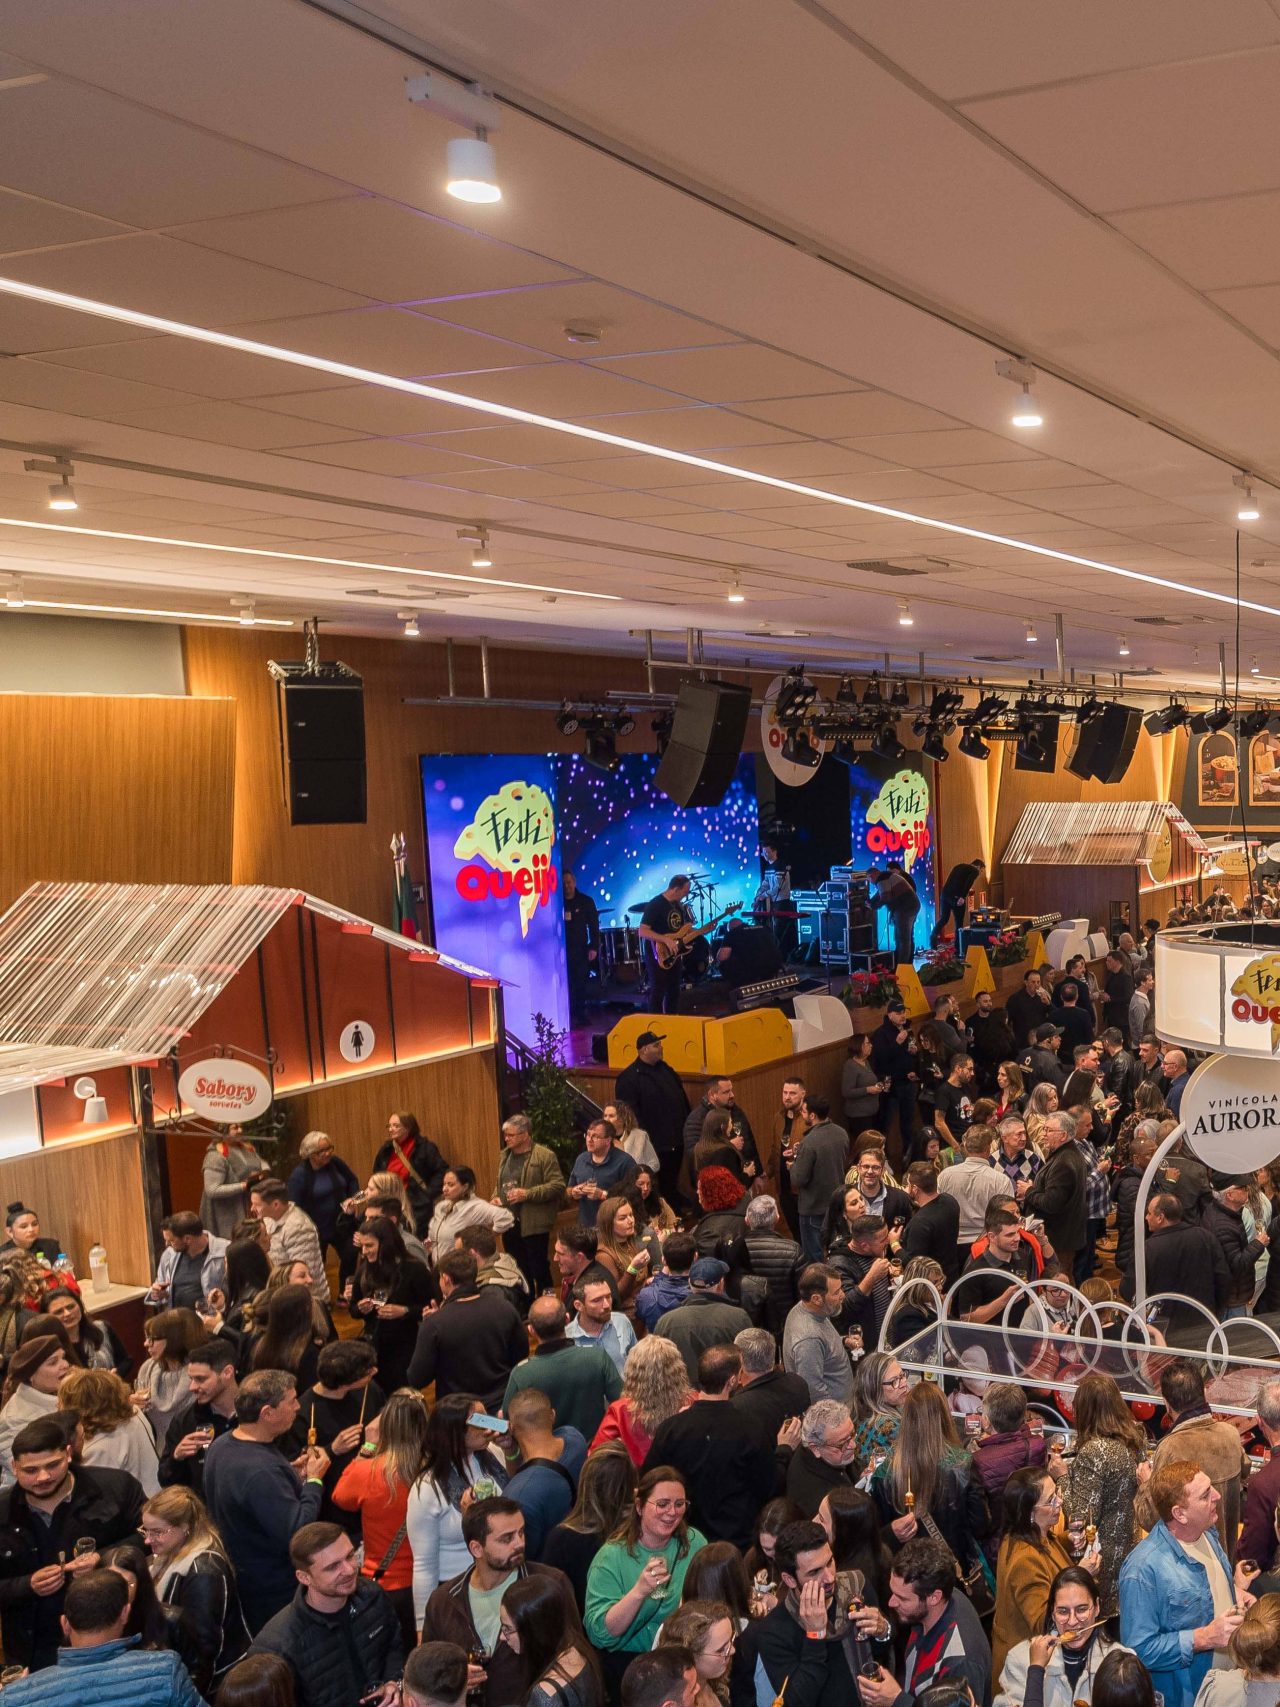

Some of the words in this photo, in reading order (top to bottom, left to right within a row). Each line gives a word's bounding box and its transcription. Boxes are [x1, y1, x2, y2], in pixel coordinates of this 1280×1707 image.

[866, 820, 930, 858] Queijo
[455, 853, 558, 908] Queijo
[195, 1077, 257, 1105] Sabory
[1208, 1094, 1278, 1109] VINÍCOLA
